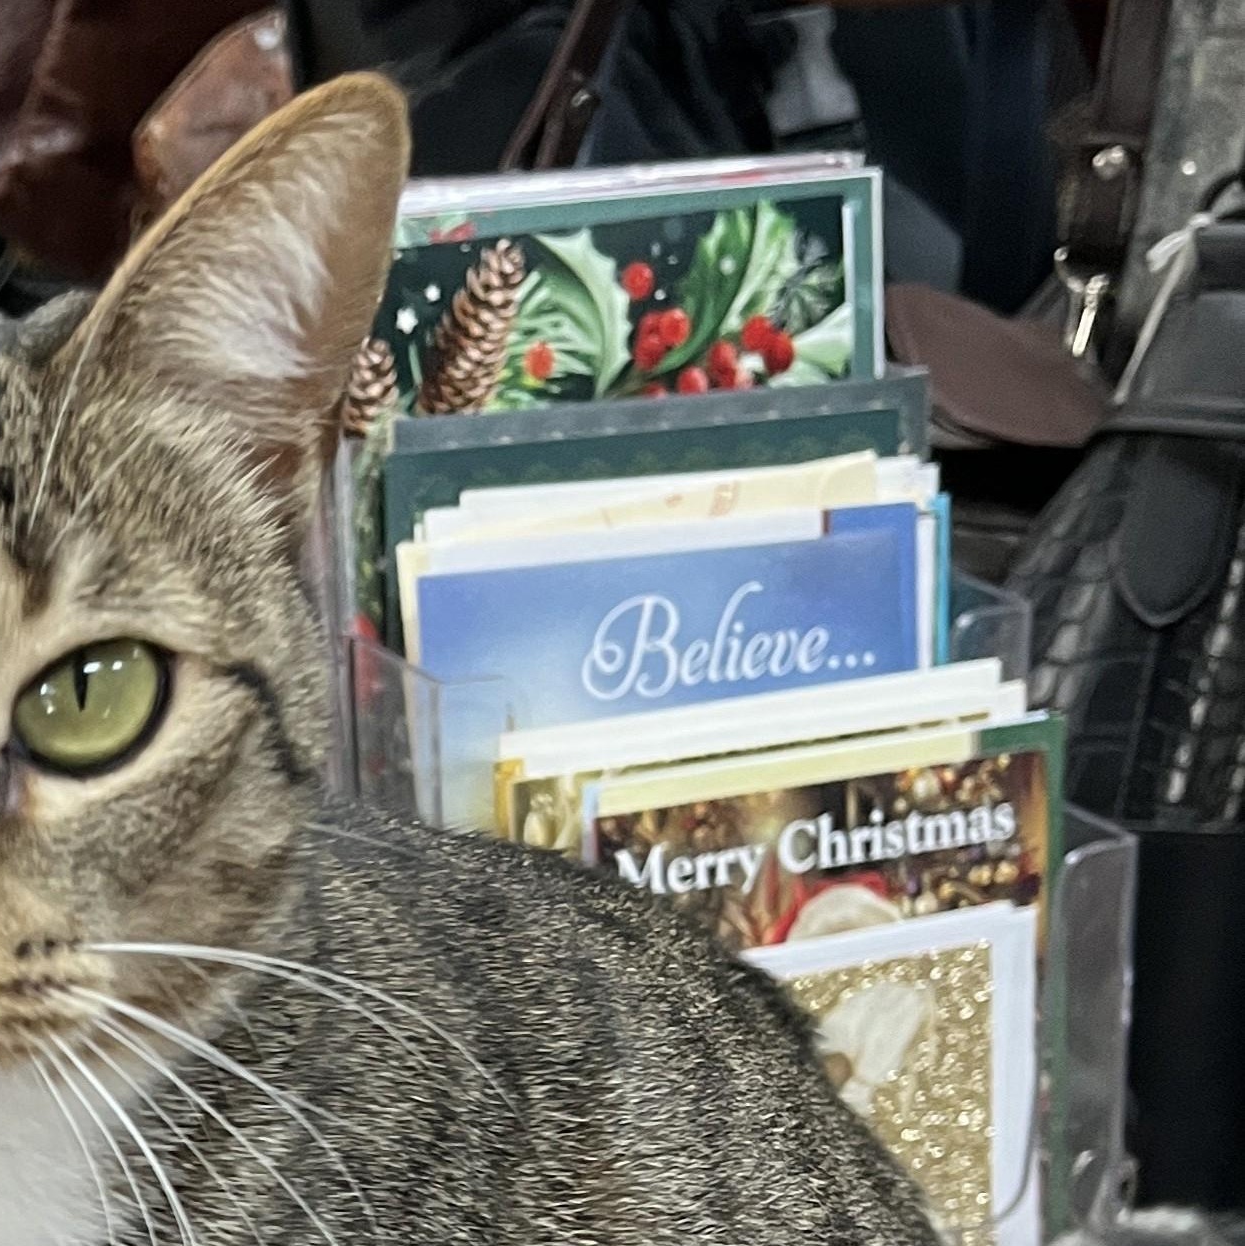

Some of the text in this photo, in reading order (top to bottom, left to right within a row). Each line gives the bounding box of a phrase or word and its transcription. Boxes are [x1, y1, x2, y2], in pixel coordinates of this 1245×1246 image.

[581, 581, 877, 700] Believe...
[615, 800, 1018, 896] Merry Christmas
